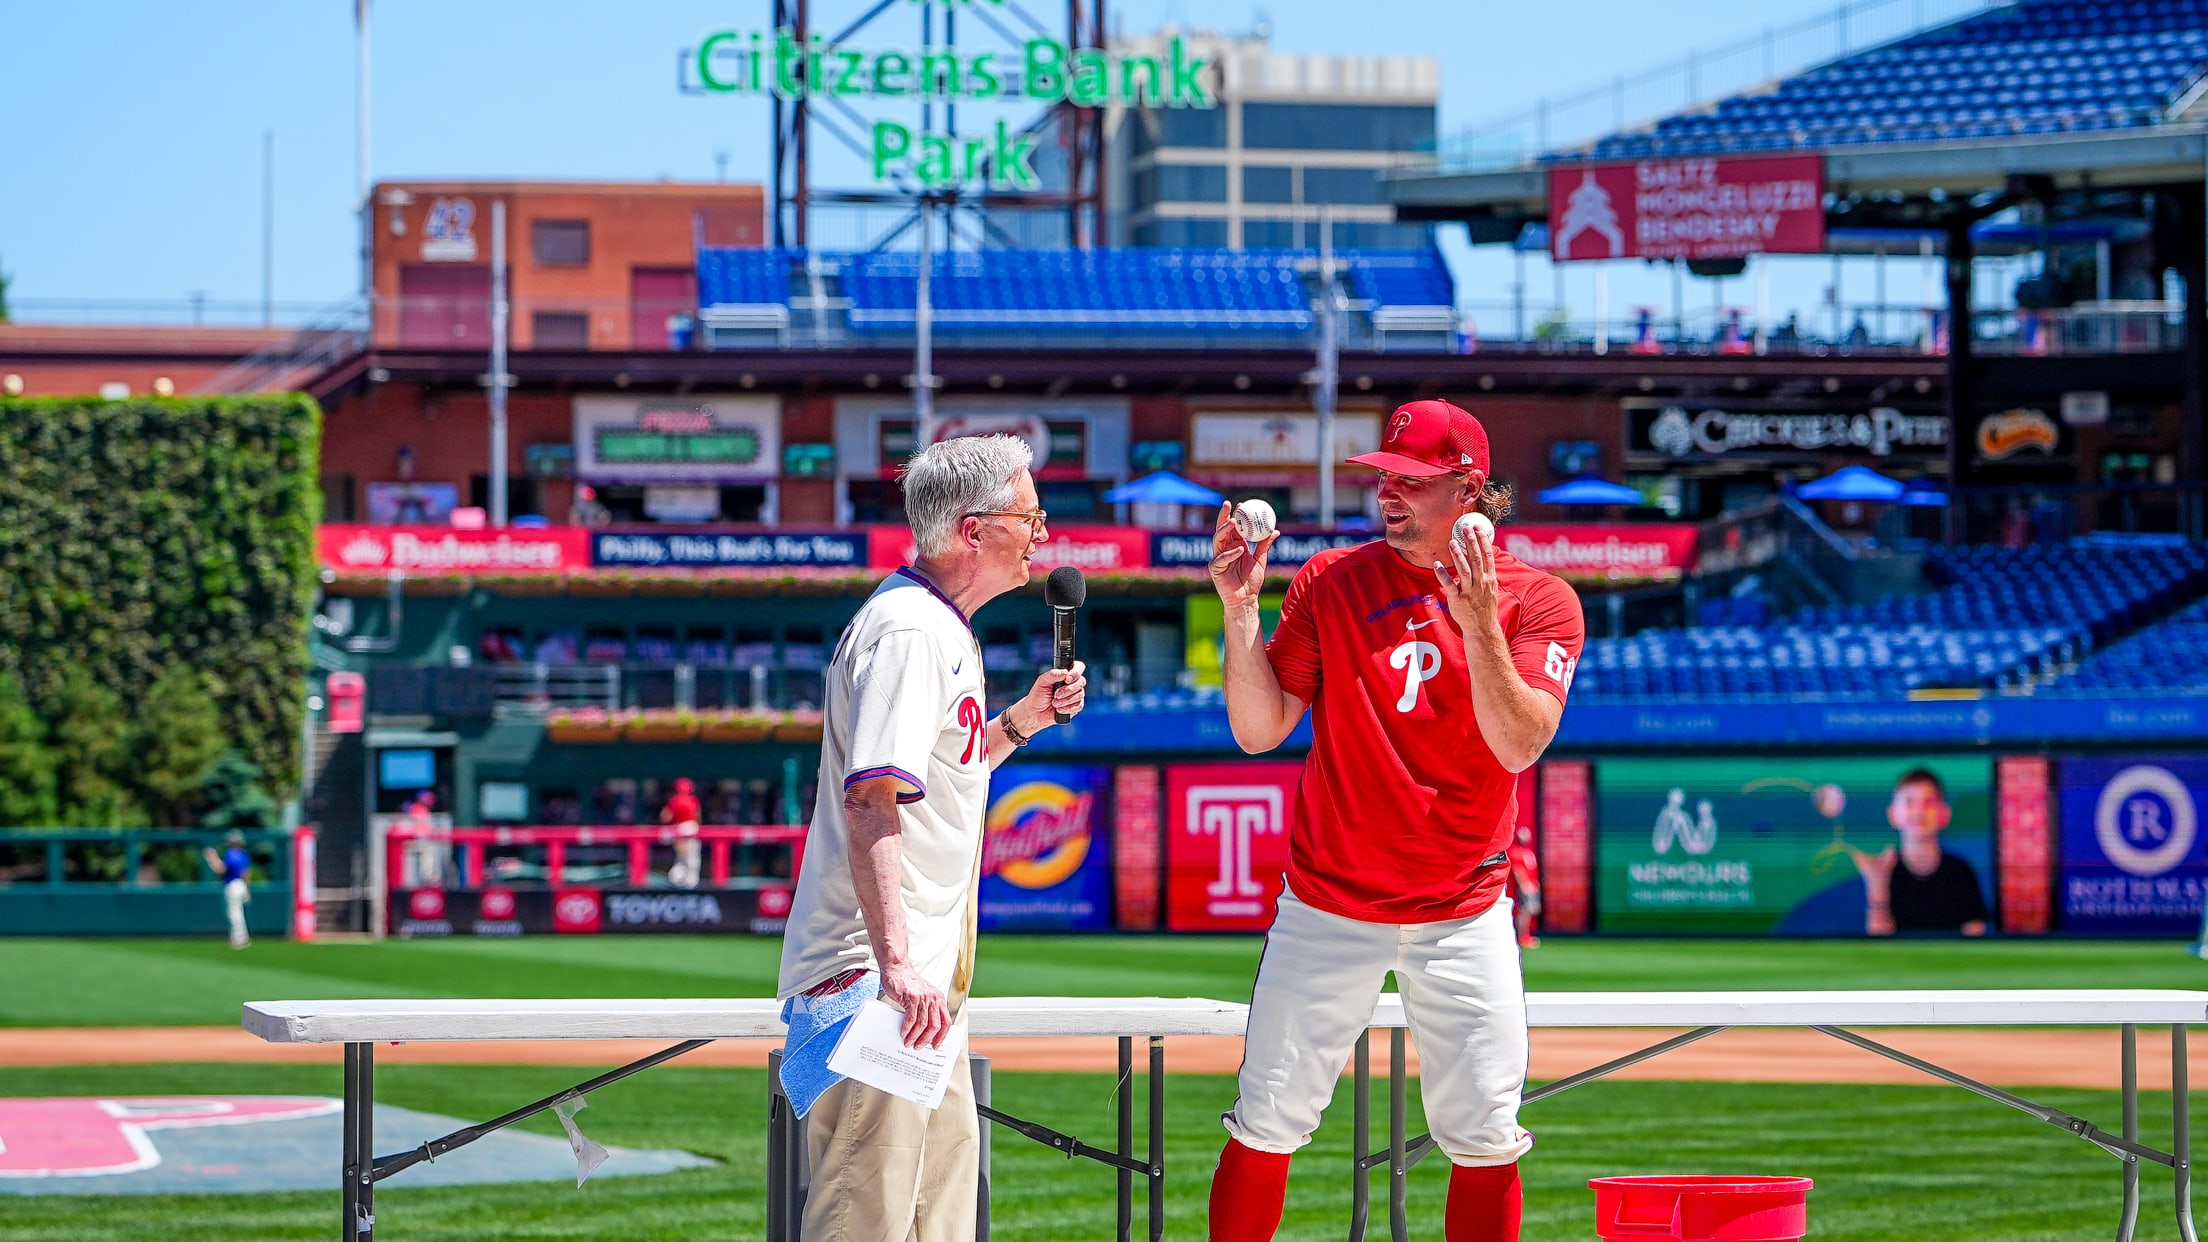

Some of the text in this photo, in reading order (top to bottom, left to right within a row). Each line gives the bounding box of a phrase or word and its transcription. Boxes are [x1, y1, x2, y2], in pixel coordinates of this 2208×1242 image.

[698, 31, 1214, 107] Citizens Bank
[872, 120, 1040, 187] Park
[1388, 411, 1412, 443] P
[390, 532, 562, 567] Budweiser
[1390, 640, 1442, 713] P
[1544, 641, 1579, 696] 58
[2128, 798, 2168, 841] R
[607, 895, 724, 924] TOYOTA
